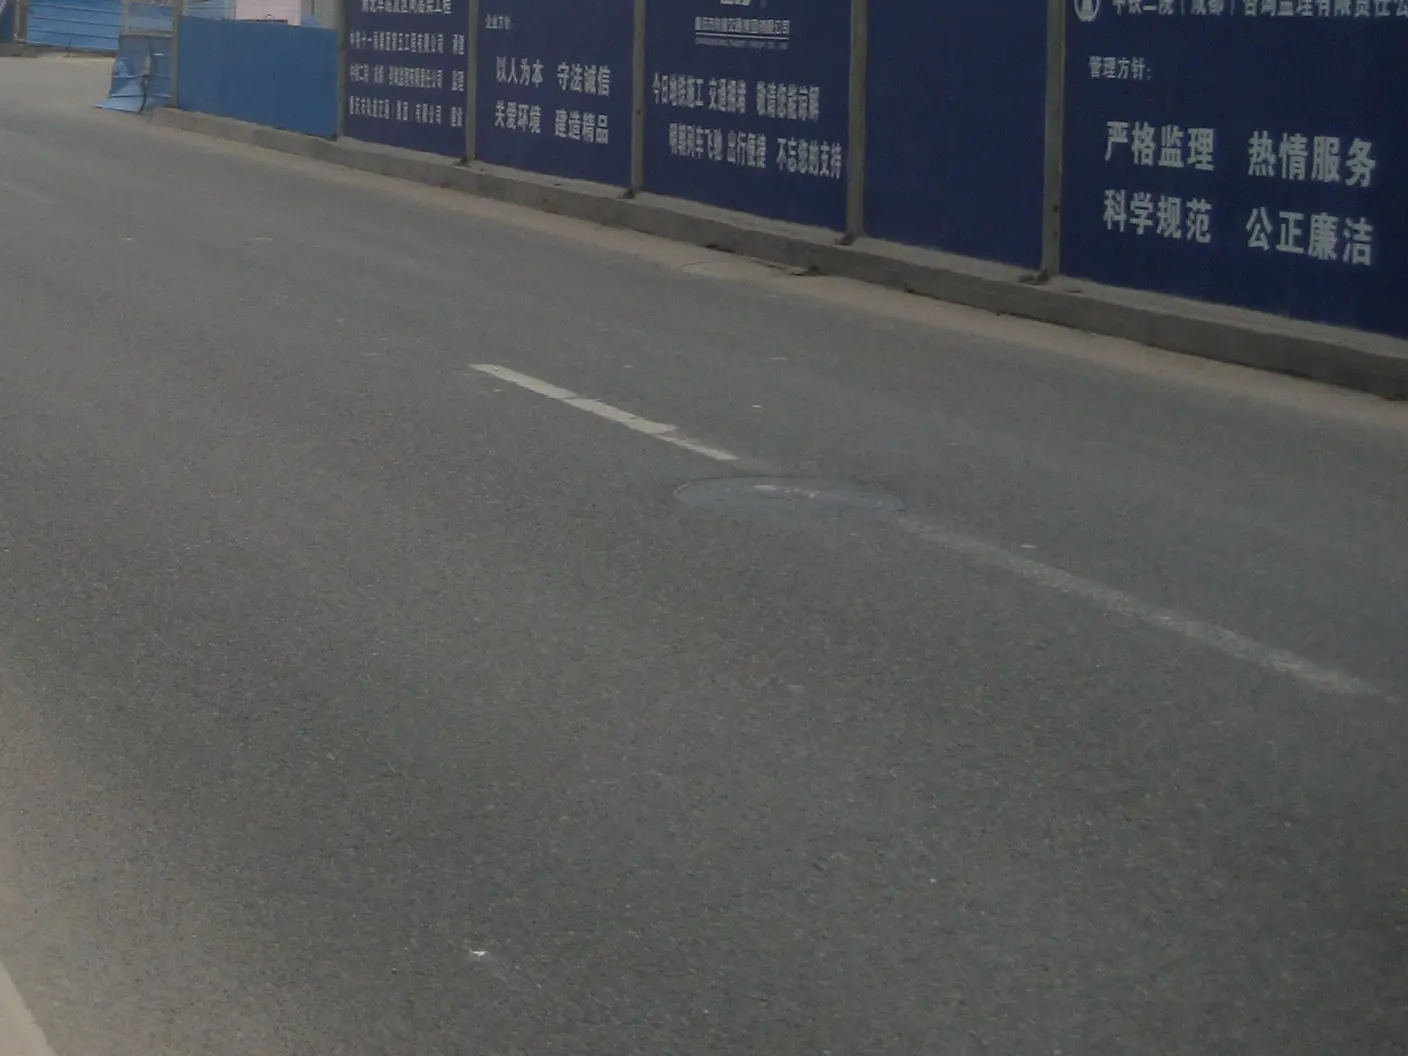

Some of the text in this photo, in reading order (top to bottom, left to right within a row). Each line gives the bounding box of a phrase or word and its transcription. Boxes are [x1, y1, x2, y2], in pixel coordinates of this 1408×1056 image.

[496, 55, 611, 98] 以人为本 守法诚信
[494, 100, 609, 145] 关爱环境 建造精品
[775, 136, 843, 180] 不忘您的支持
[1105, 119, 1377, 189] 严格监理 热情服务
[1103, 188, 1375, 266] 科学规范 公正廉洁
